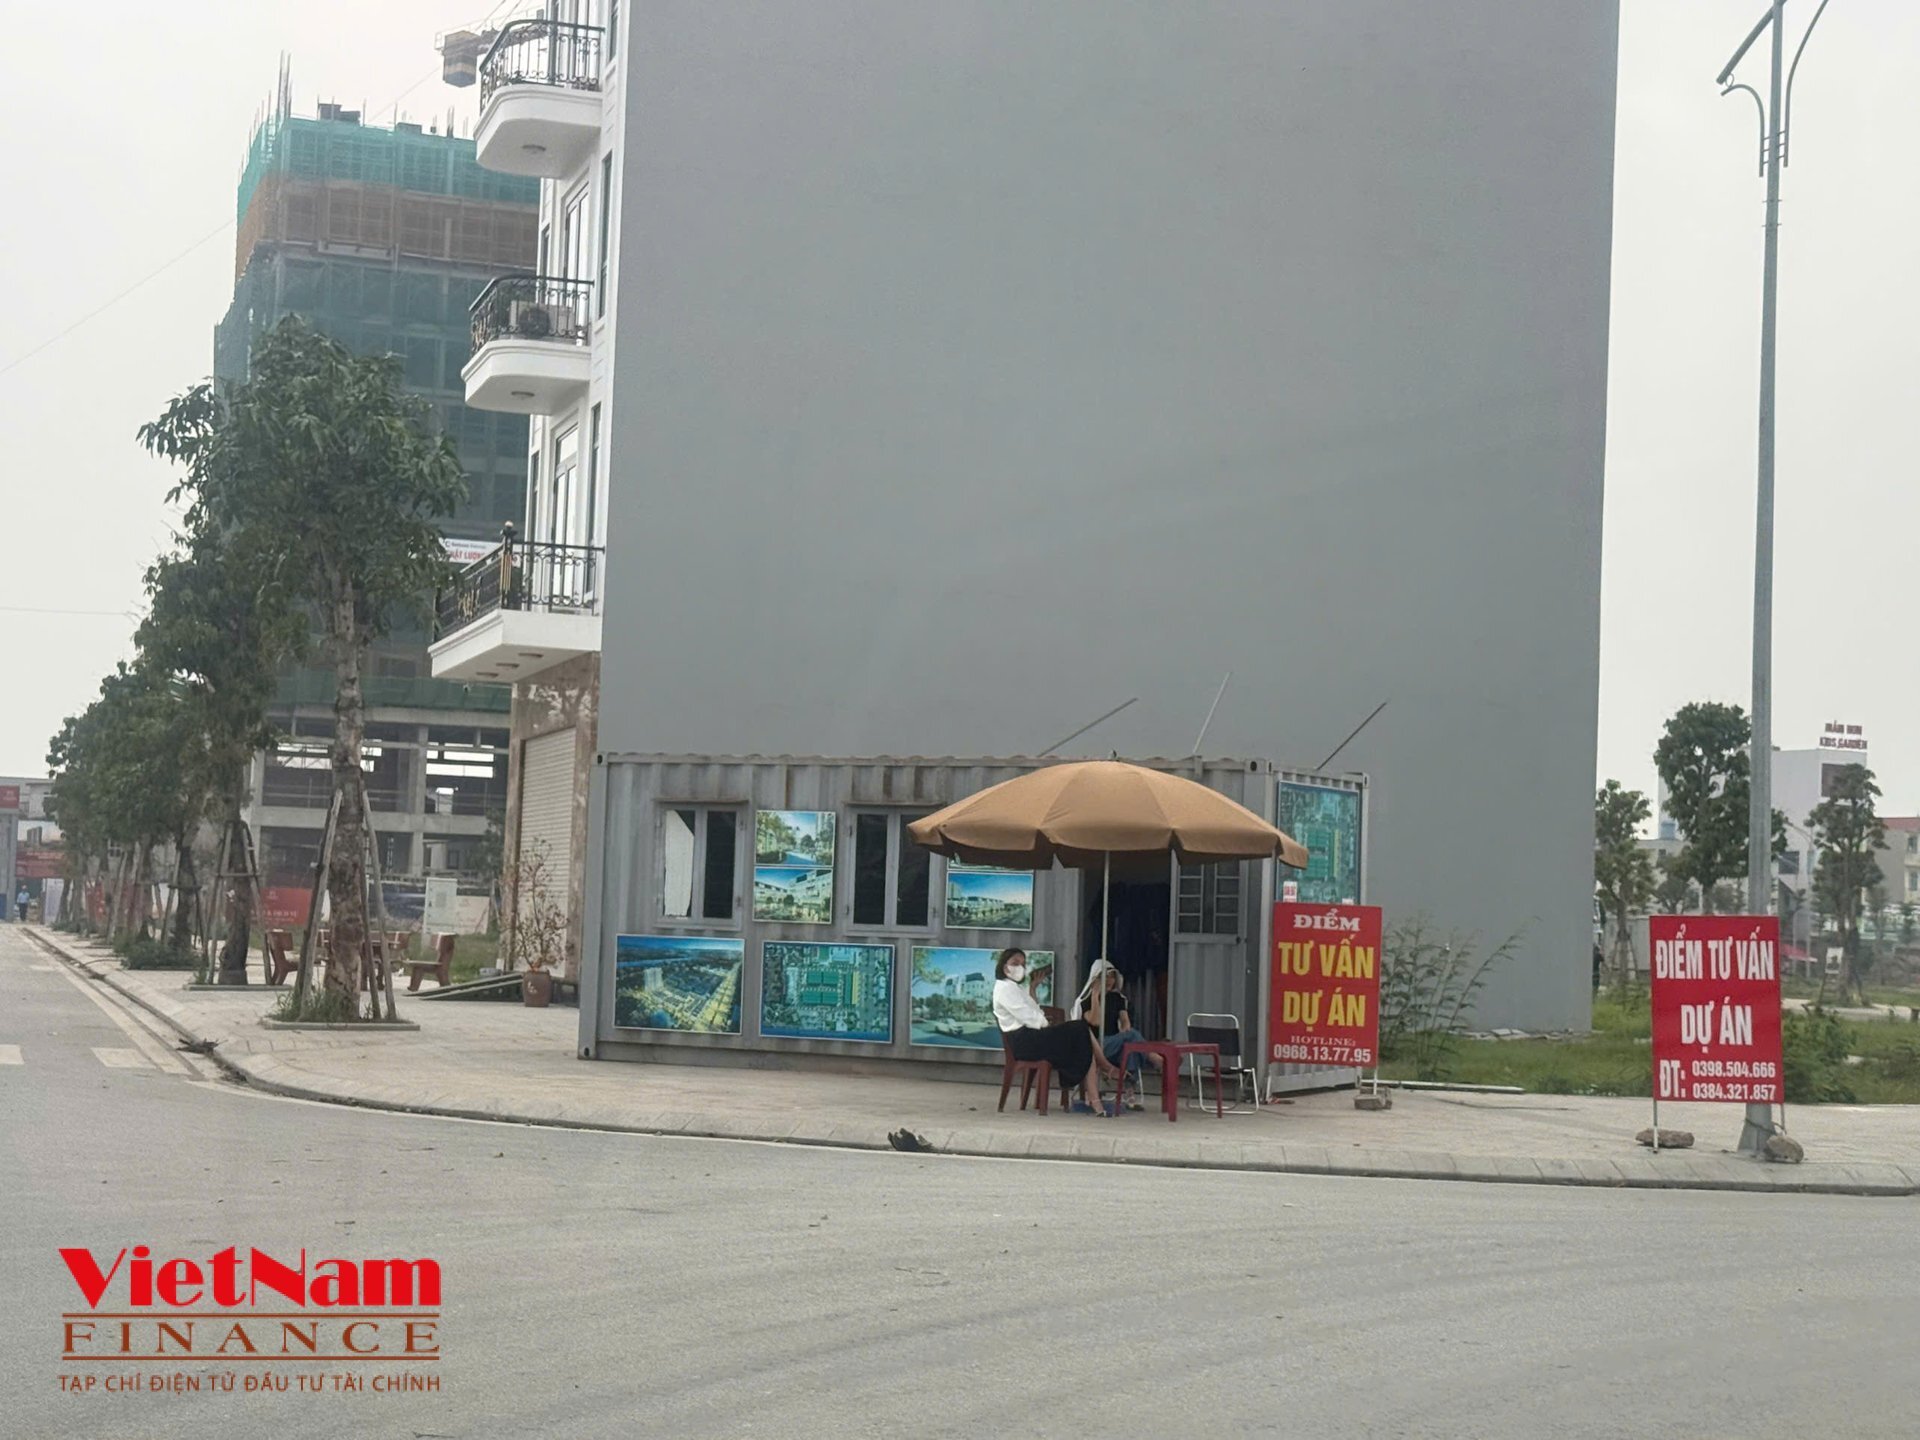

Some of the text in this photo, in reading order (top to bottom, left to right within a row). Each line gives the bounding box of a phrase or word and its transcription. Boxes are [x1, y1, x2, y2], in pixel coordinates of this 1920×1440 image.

[1293, 908, 1361, 931] ĐIỂM
[1278, 934, 1375, 979] TƯ VẤN
[1655, 923, 1775, 980] ĐIỂM TƯ VẤN
[1283, 987, 1366, 1032] DỰ ÁN
[1681, 996, 1753, 1054] DỰ ÁN
[1273, 1044, 1371, 1063] 0968.13.77.95
[1659, 1059, 1776, 1098] ĐT: 0398.504.666
[1692, 1082, 1776, 1100] 0384.321.857
